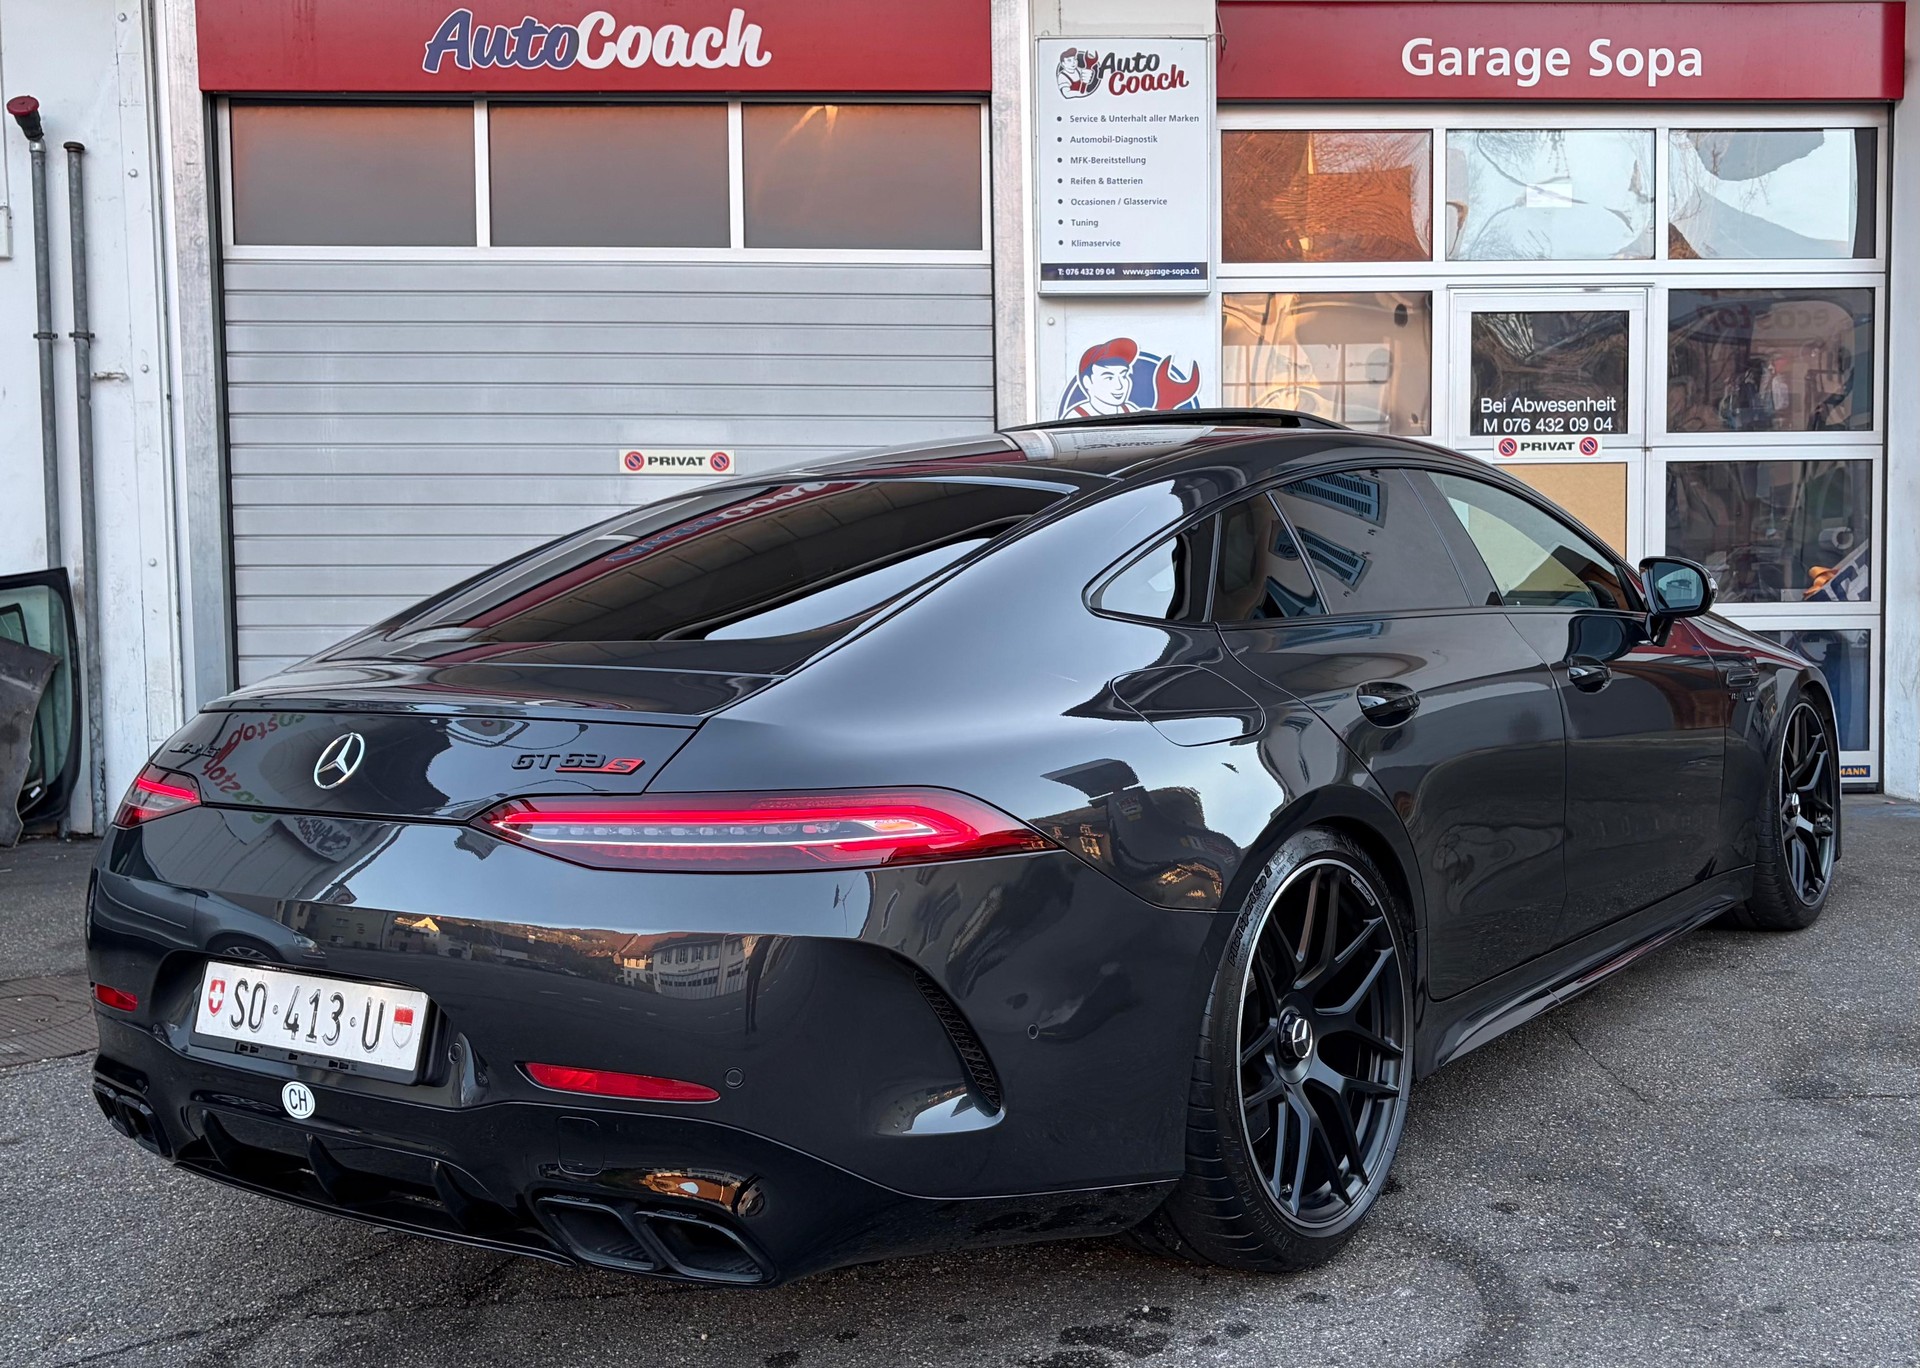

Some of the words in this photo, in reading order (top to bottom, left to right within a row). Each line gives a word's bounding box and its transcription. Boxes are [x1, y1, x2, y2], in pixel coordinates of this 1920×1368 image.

[422, 8, 772, 74] AutoCoach
[1099, 52, 1160, 79] Auto
[1401, 37, 1571, 87] Garage
[1588, 38, 1703, 87] Sopa
[1108, 64, 1189, 96] Coach
[1070, 114, 1098, 123] Service
[1100, 114, 1107, 123] &
[1108, 114, 1147, 123] Unterhalt
[1149, 114, 1167, 123] aller
[1168, 114, 1200, 122] Marken
[1070, 135, 1158, 145] Automobil-Diagnostik
[1070, 156, 1146, 165] MFK-Bereitstellung
[1070, 176, 1096, 185] Reifen
[1098, 177, 1105, 185] &
[1106, 177, 1143, 185] Batterien
[1070, 197, 1116, 206] Occasionen
[1123, 197, 1167, 206] Glasservice
[1070, 218, 1099, 228] Tuning
[1071, 238, 1121, 247] Klimaservice
[1065, 268, 1079, 276] 076
[1080, 268, 1094, 276] 432
[1095, 268, 1105, 276] 09
[1106, 268, 1115, 276] 04
[1122, 267, 1200, 277] www.garage-sopa.ch
[1480, 397, 1507, 413] Bei
[1511, 396, 1617, 413] Abwesenheit
[1483, 418, 1498, 433] M
[1503, 418, 1531, 433] 076
[1535, 418, 1564, 432] 432
[1569, 417, 1589, 432] 09
[1593, 417, 1613, 431] 04
[1520, 441, 1576, 451] PRIVAT
[647, 456, 706, 466] PRIVAT
[511, 754, 560, 769] GT
[560, 753, 606, 769] 63
[607, 758, 636, 771] S
[1227, 926, 1244, 967] Pilot
[1238, 891, 1257, 931] Sport
[1252, 874, 1268, 897] Cup
[288, 1088, 309, 1112] CH
